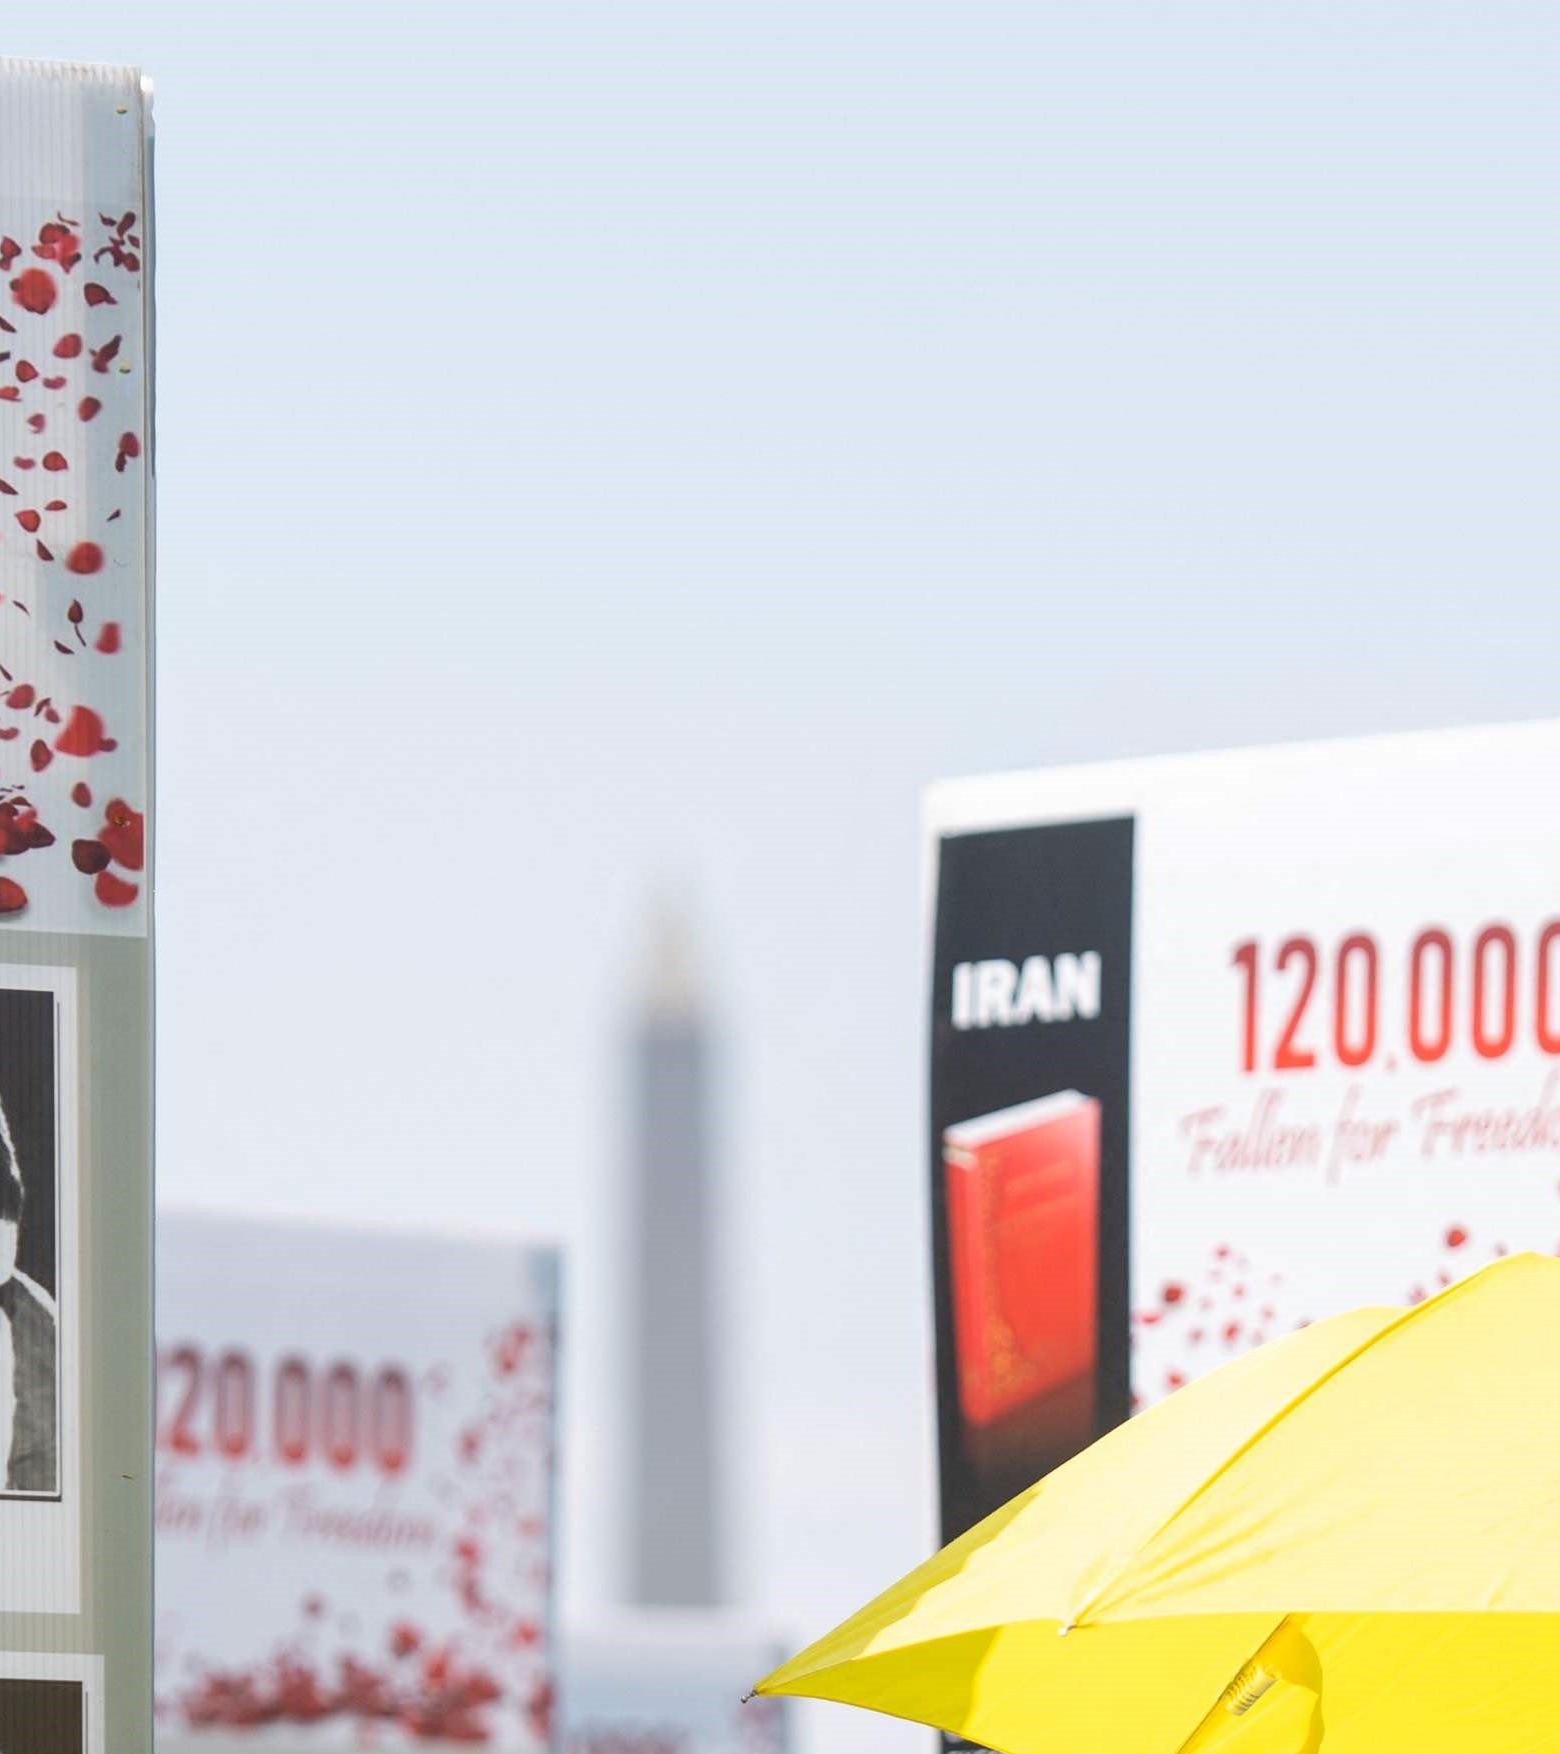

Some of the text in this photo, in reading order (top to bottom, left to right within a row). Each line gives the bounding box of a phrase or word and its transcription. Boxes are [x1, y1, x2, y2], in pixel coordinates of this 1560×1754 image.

[951, 952, 1102, 1029] IRAN
[1178, 1083, 1319, 1177] Fallen
[1328, 1085, 1396, 1185] for
[156, 1344, 415, 1479] 20,000
